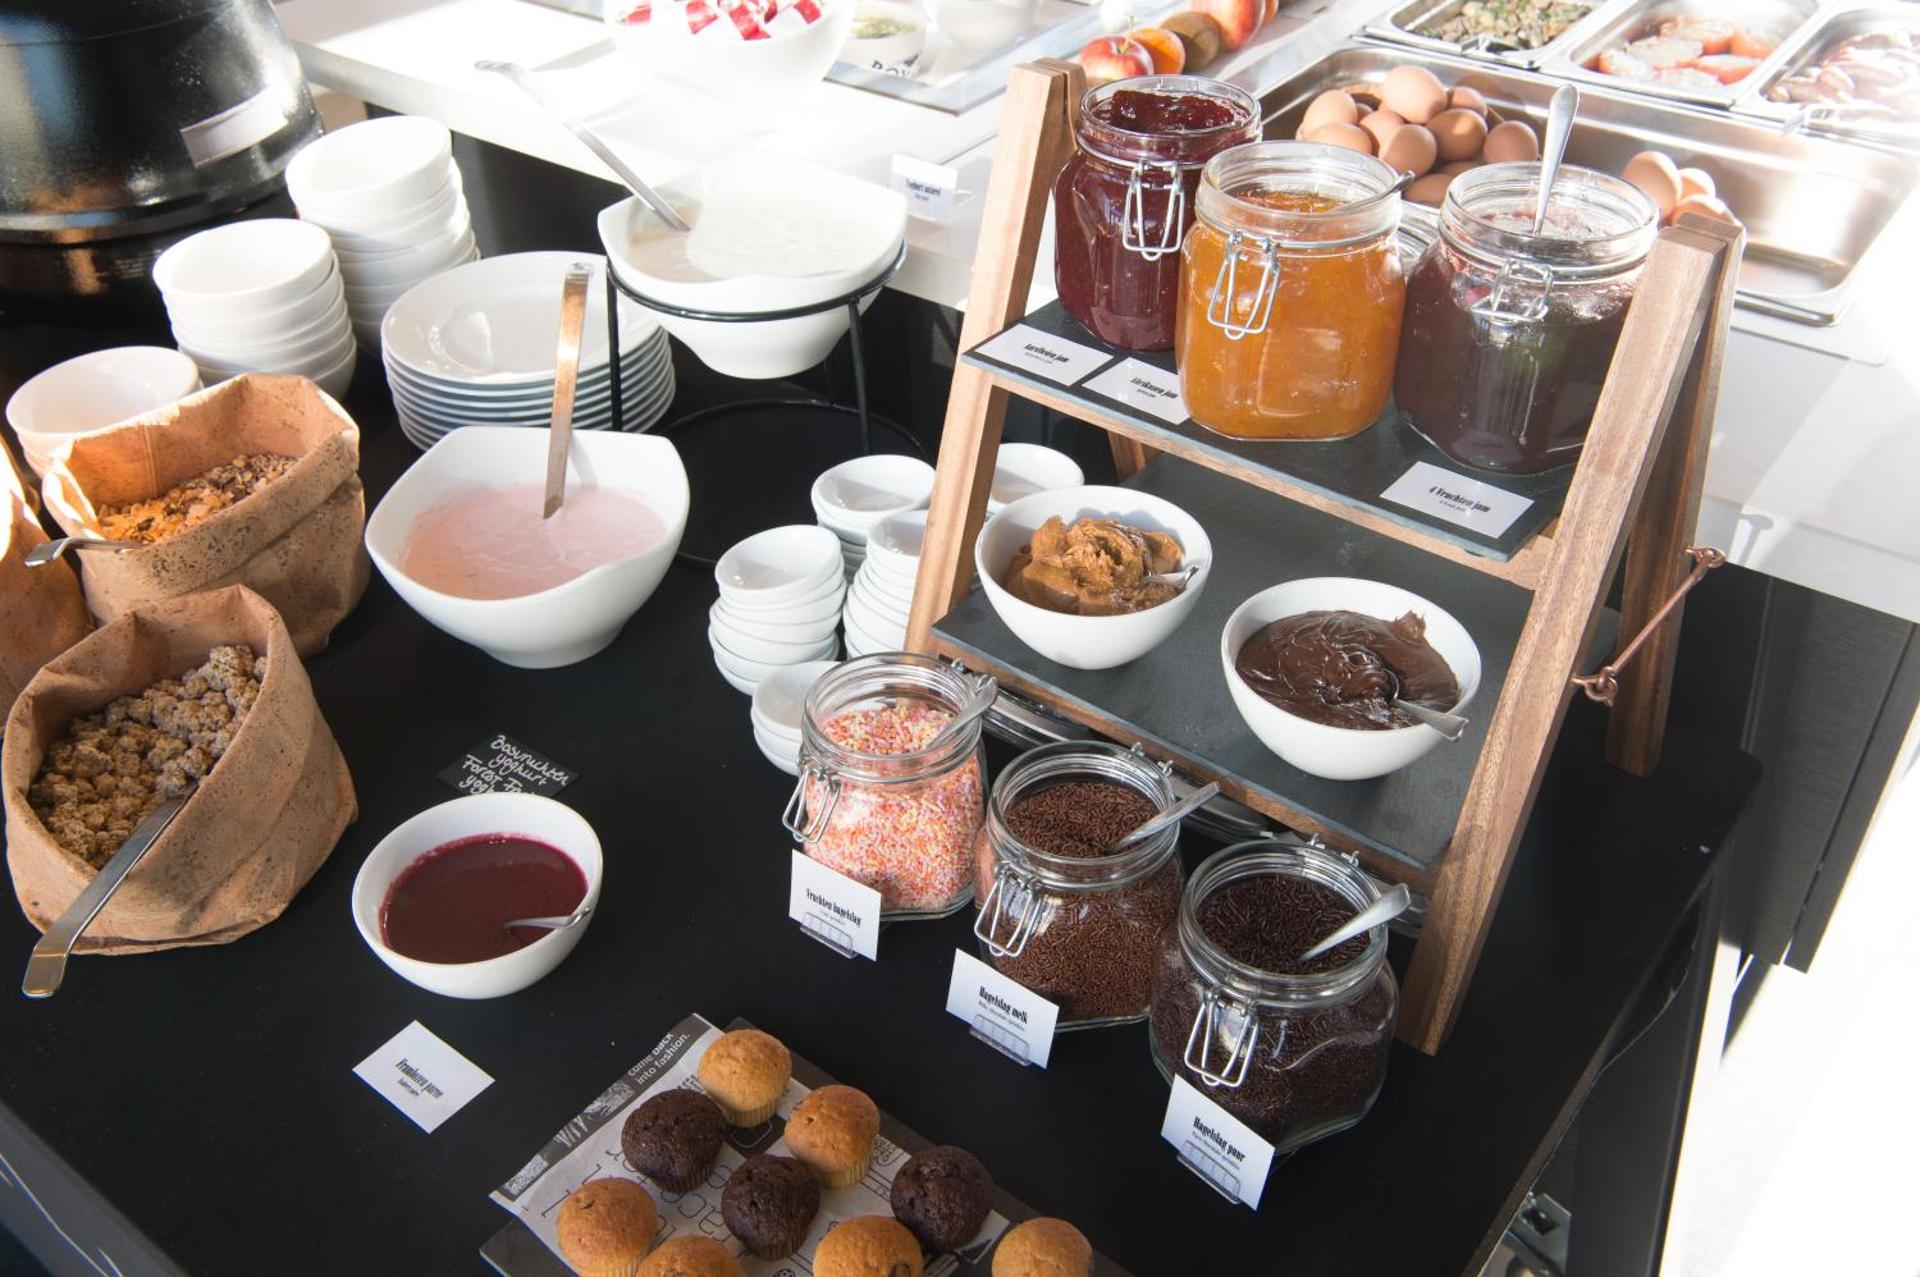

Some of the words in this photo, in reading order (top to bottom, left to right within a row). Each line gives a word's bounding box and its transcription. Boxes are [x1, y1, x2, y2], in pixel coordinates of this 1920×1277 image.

[635, 1067, 657, 1085] into
[654, 1033, 690, 1068] fashion.
[1193, 1116, 1228, 1151] Hagelslag
